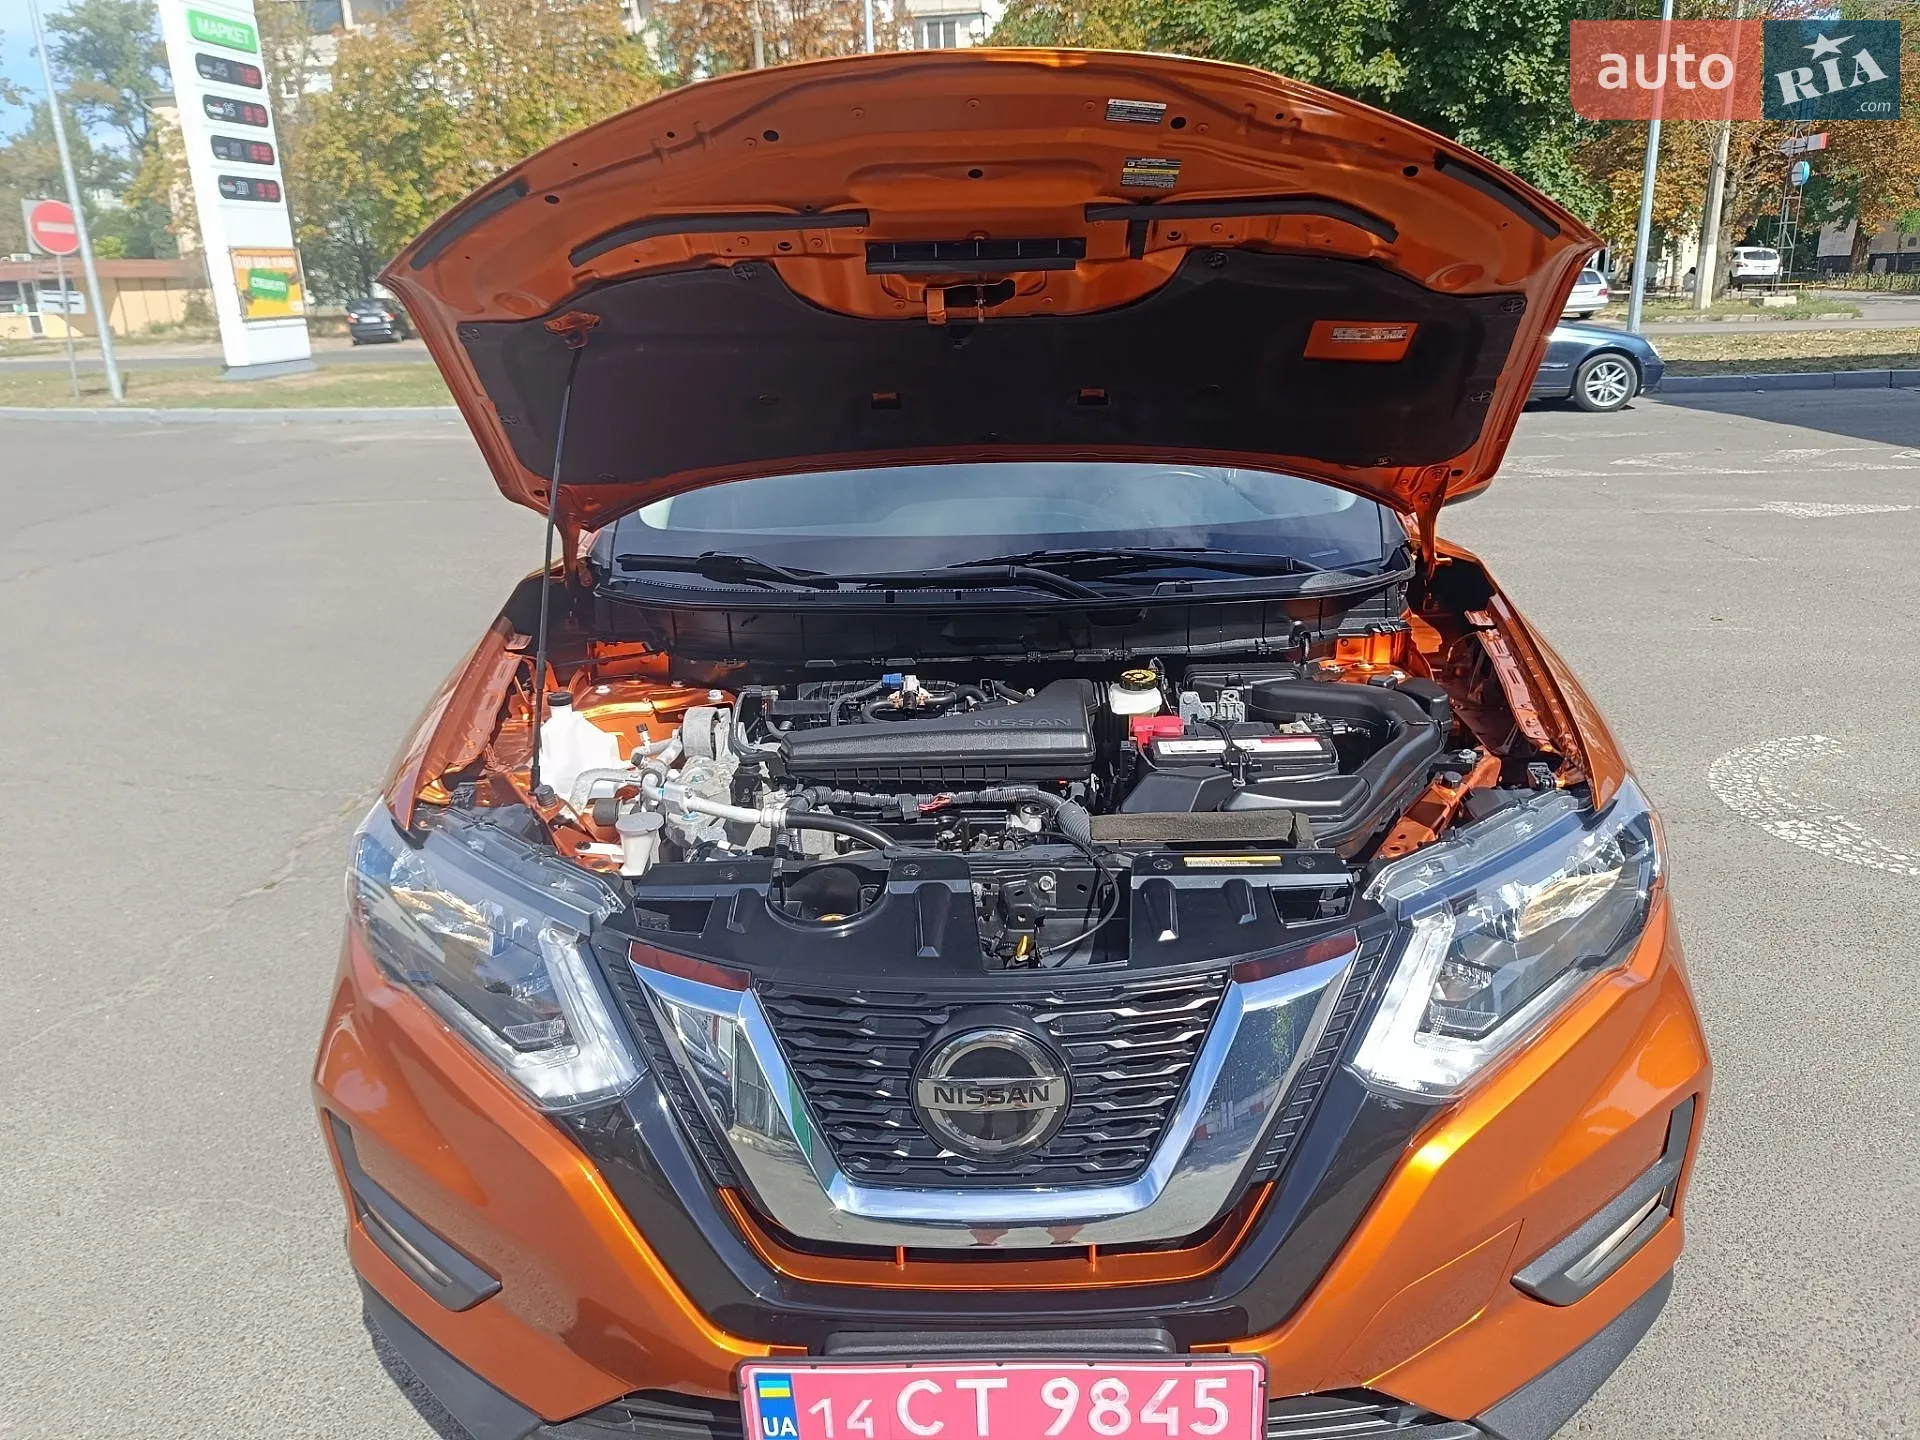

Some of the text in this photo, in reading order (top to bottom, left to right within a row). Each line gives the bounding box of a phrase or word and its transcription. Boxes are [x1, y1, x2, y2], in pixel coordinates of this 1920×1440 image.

[196, 17, 250, 45] МАРКЕТ
[974, 718, 1072, 728] NISSAN
[933, 1085, 1049, 1105] NISSAN
[807, 1376, 1229, 1438] 14 CT 9845
[762, 1416, 798, 1436] UA
